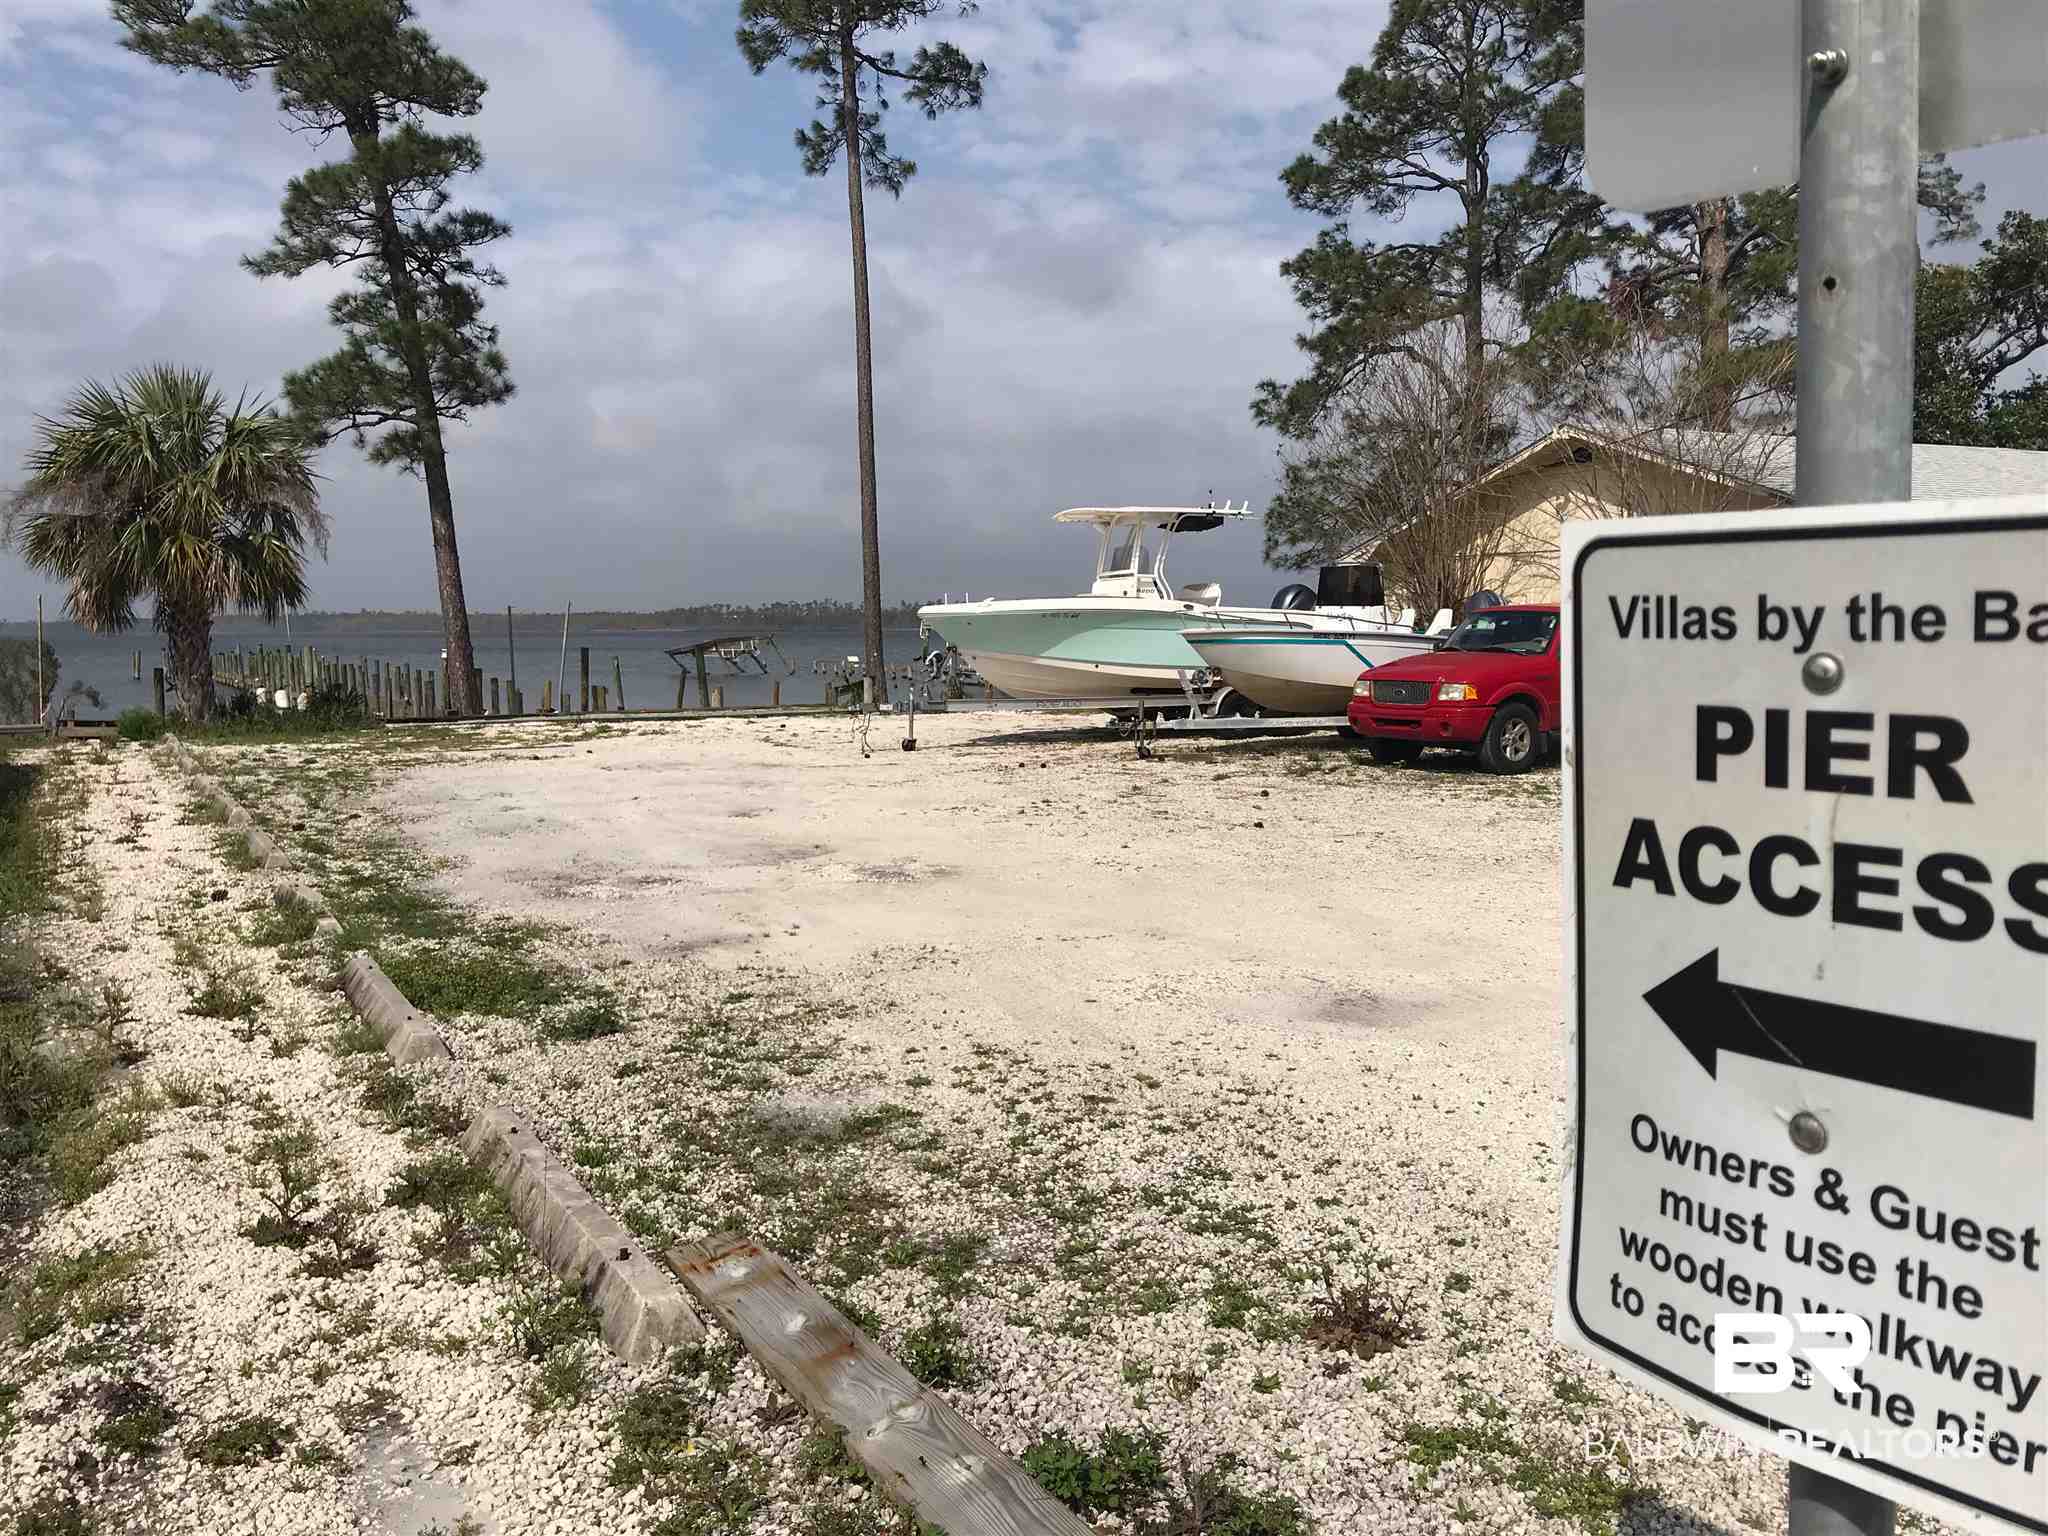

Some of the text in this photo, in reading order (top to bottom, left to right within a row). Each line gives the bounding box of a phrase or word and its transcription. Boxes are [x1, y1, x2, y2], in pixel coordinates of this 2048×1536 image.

[1608, 595, 1738, 640] Villas
[1757, 594, 1825, 654] by
[1845, 592, 1947, 643] the
[1696, 704, 1975, 805] PIER
[1612, 817, 2048, 954] ACCESS
[1630, 1113, 2041, 1271] Owners & Guest
[1610, 1272, 1645, 1317] to
[1619, 1227, 1783, 1316] wooden
[1659, 1188, 1984, 1319] must use the
